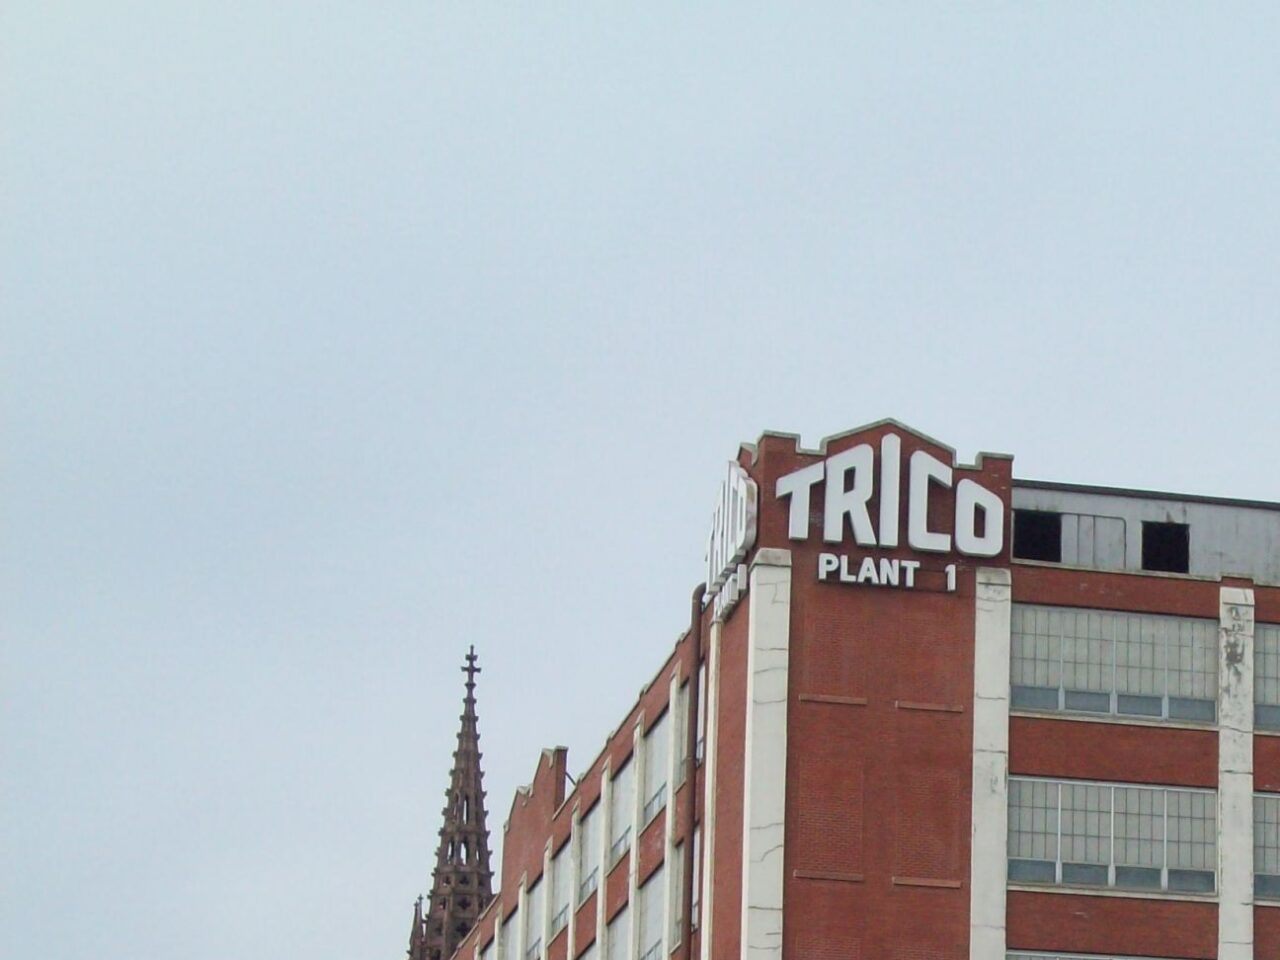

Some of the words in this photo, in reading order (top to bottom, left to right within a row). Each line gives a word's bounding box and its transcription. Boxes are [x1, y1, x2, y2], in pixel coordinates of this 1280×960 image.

[776, 433, 1004, 557] TRICO
[818, 553, 920, 587] PLANT
[945, 564, 957, 591] 1
